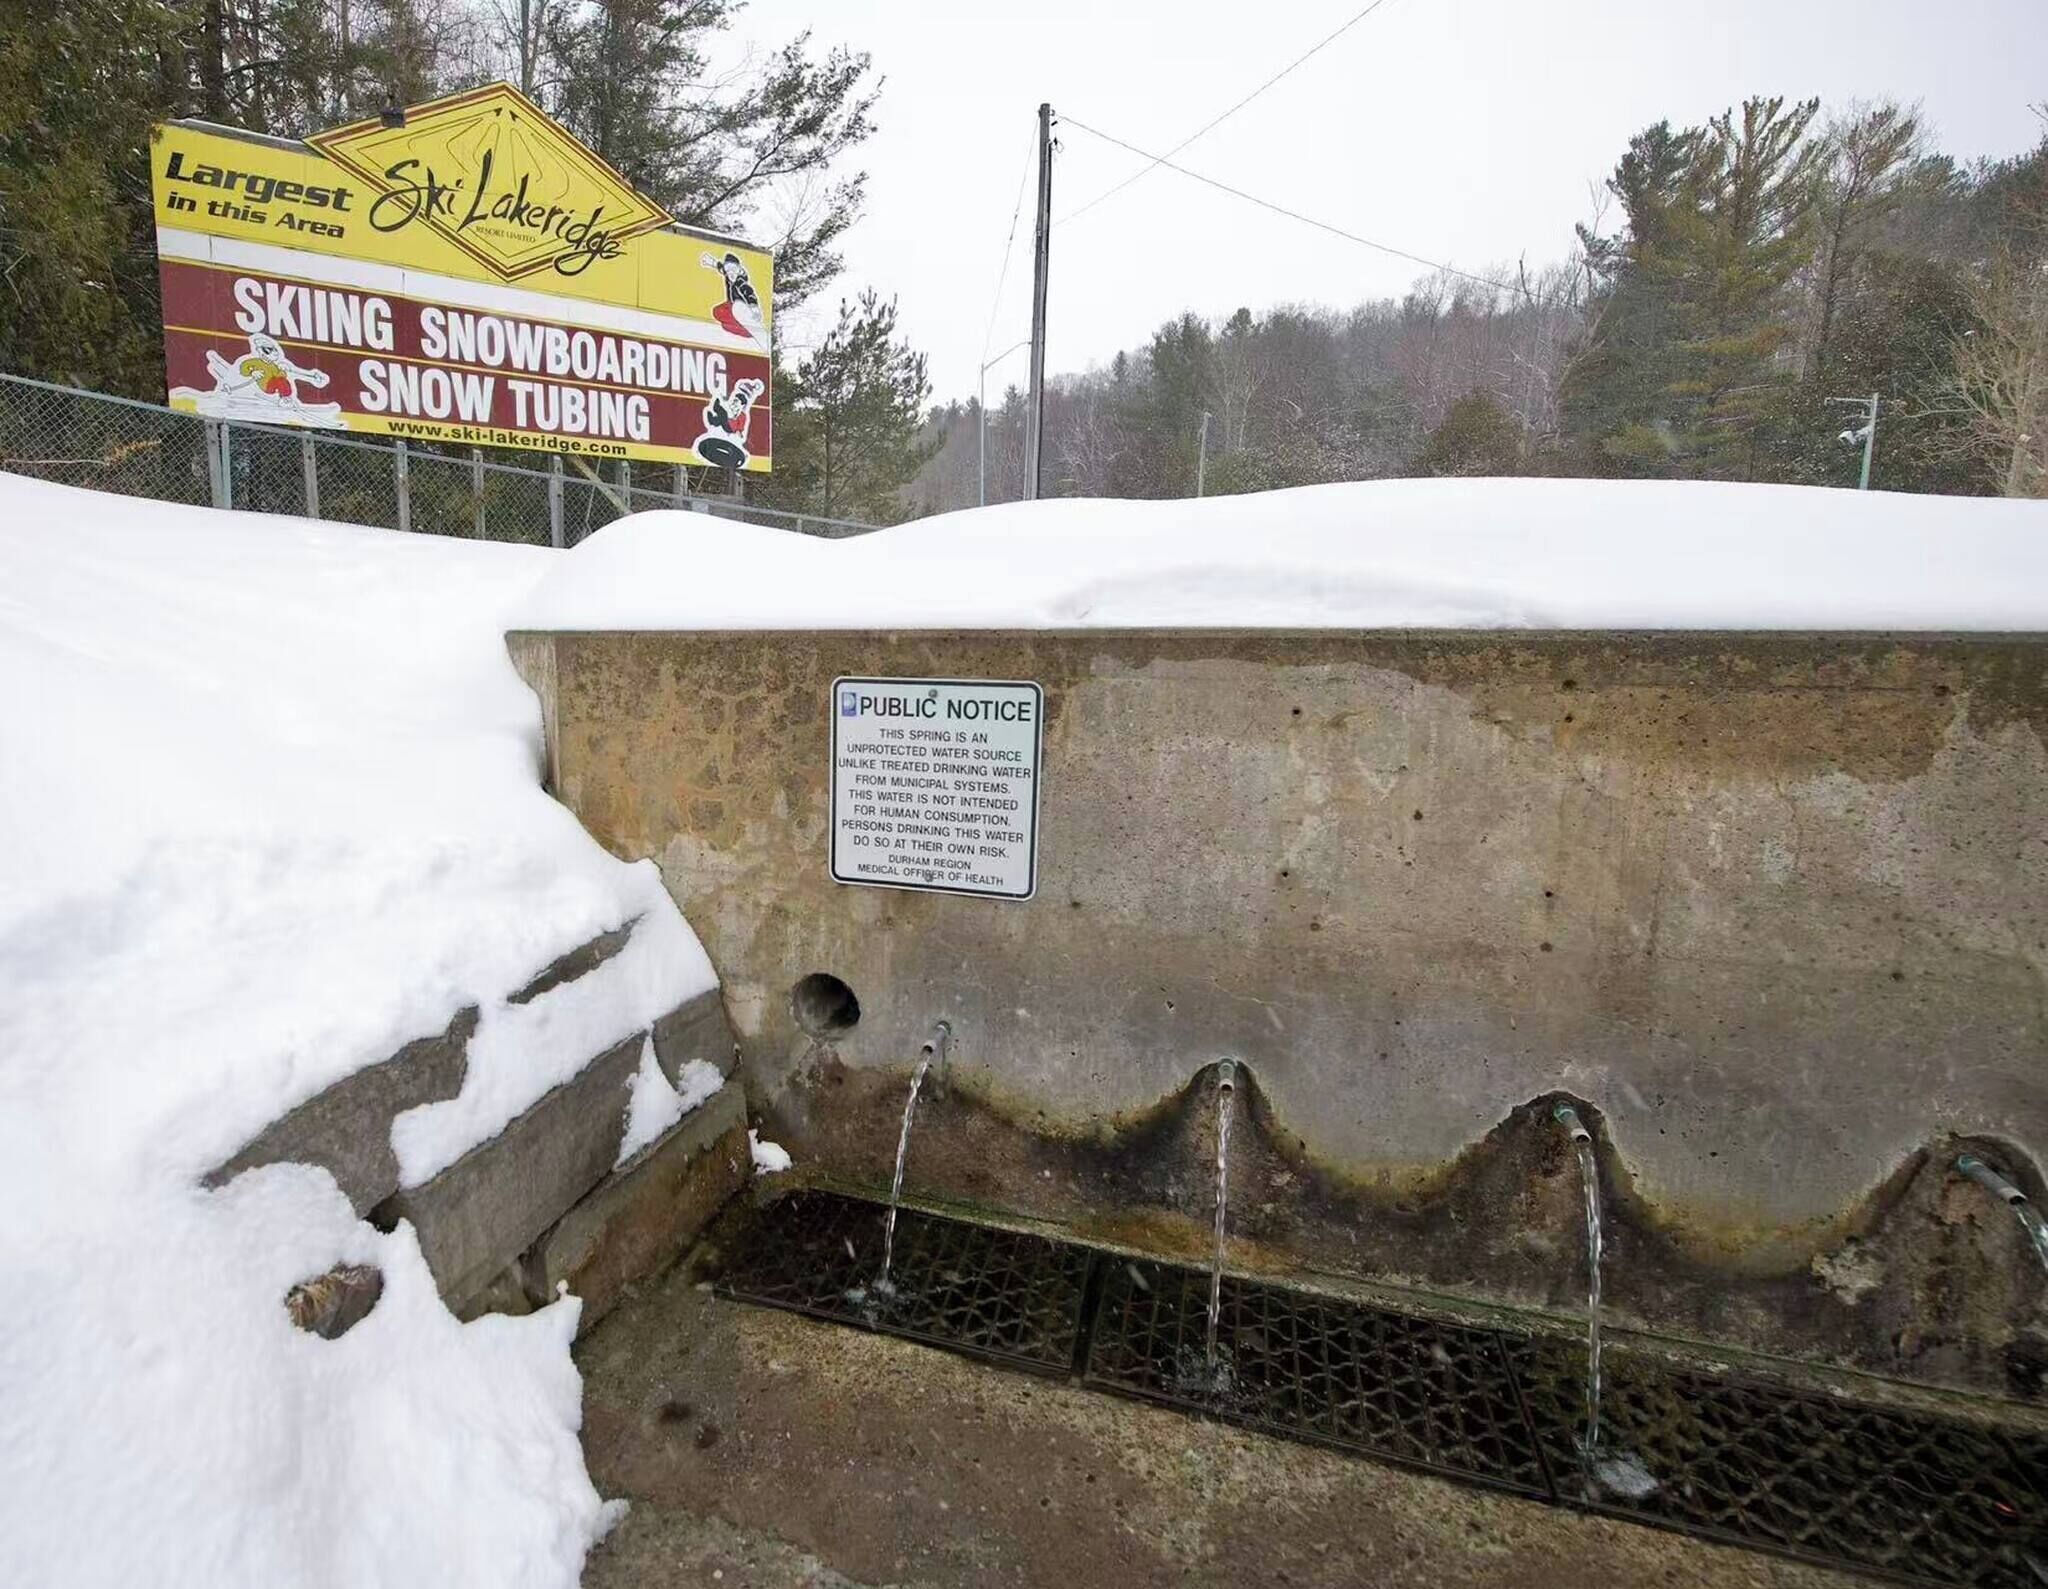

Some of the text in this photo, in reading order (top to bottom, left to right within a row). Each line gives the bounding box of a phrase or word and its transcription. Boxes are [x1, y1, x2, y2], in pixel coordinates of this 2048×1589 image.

[165, 152, 354, 212] Largest
[167, 191, 344, 238] in this Area
[369, 148, 628, 276] Ski Lakeridge
[234, 277, 727, 401] SKIING SNOWBOARDING
[359, 359, 650, 442] SNOW TUBING
[388, 421, 626, 455] www.ski-lakeridge.com
[860, 697, 1031, 722] PUBLIC NOTICE
[880, 729, 988, 743] THIS SPRING IS AN
[847, 743, 1022, 762] UNPROTECTED WATER SOURCE
[838, 759, 1031, 779] UNLIKE TREATED DRINKING WATER
[856, 774, 1011, 794] FROM MUNICIPAL SYSTEMS.
[849, 789, 1018, 810] THIS WATER IS NOT INTENDED
[854, 804, 1011, 826] FOR HUMAN CONSUMPTION.
[842, 819, 1023, 843] PERSONS DRINKING THIS WATER
[854, 835, 1009, 859] DO SO AT THEIR OWN RISK.
[889, 854, 971, 870] DURHAM REGION
[858, 864, 899, 875] MEDICAL
[948, 871, 962, 882] OF
[966, 873, 1003, 886] HEALTH
